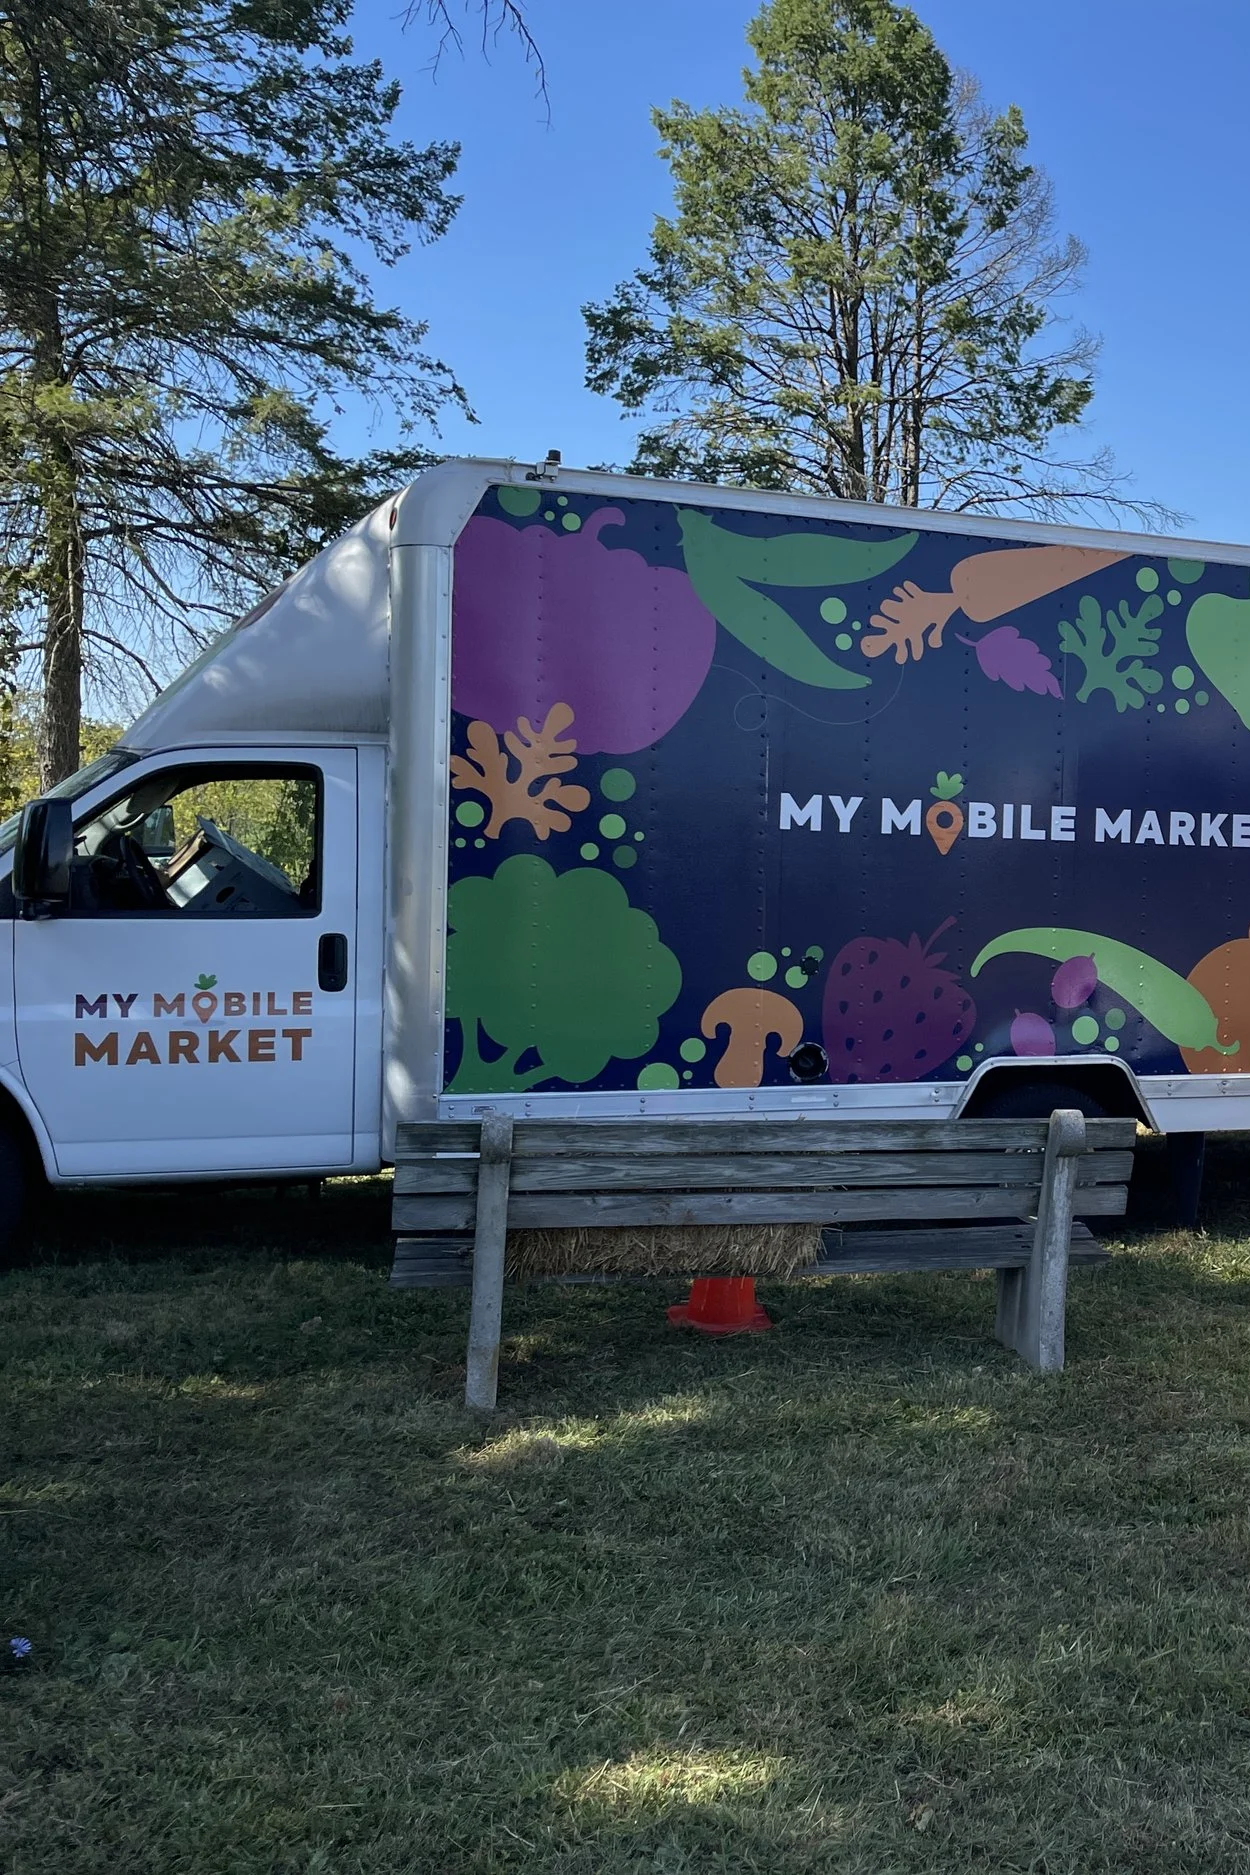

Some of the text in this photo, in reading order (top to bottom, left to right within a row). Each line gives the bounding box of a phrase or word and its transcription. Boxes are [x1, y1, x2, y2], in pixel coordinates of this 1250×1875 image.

[779, 792, 864, 833] MY
[881, 796, 1077, 855] MOBILE
[75, 991, 313, 1024] MY MOBILE
[74, 1028, 313, 1067] MARKET
